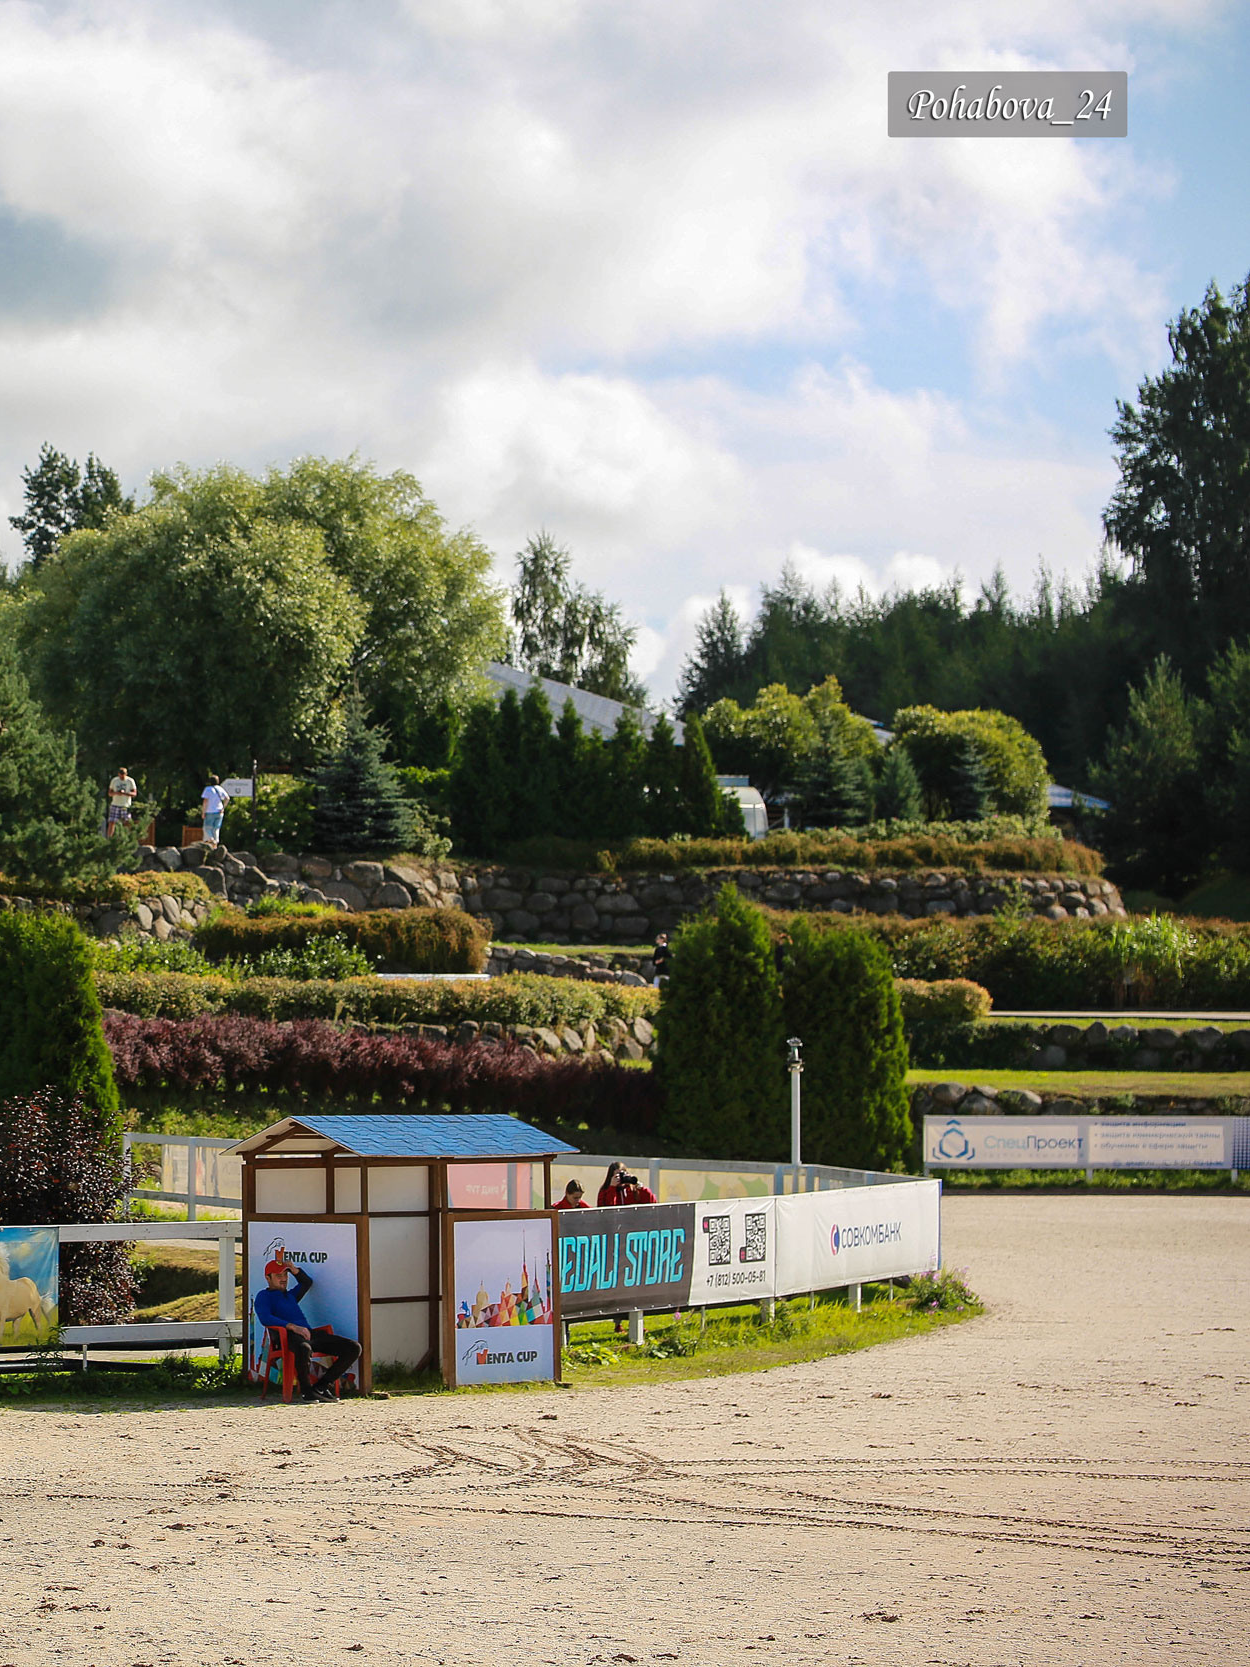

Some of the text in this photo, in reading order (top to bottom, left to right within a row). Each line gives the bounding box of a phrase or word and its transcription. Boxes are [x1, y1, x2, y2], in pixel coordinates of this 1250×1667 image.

[983, 1135, 1083, 1152] СпецПроект
[841, 1221, 902, 1249] СОВКОМБАНК
[309, 1252, 328, 1263] CUP
[624, 1228, 685, 1287] STORE
[476, 1348, 538, 1365] VENTA CUP
